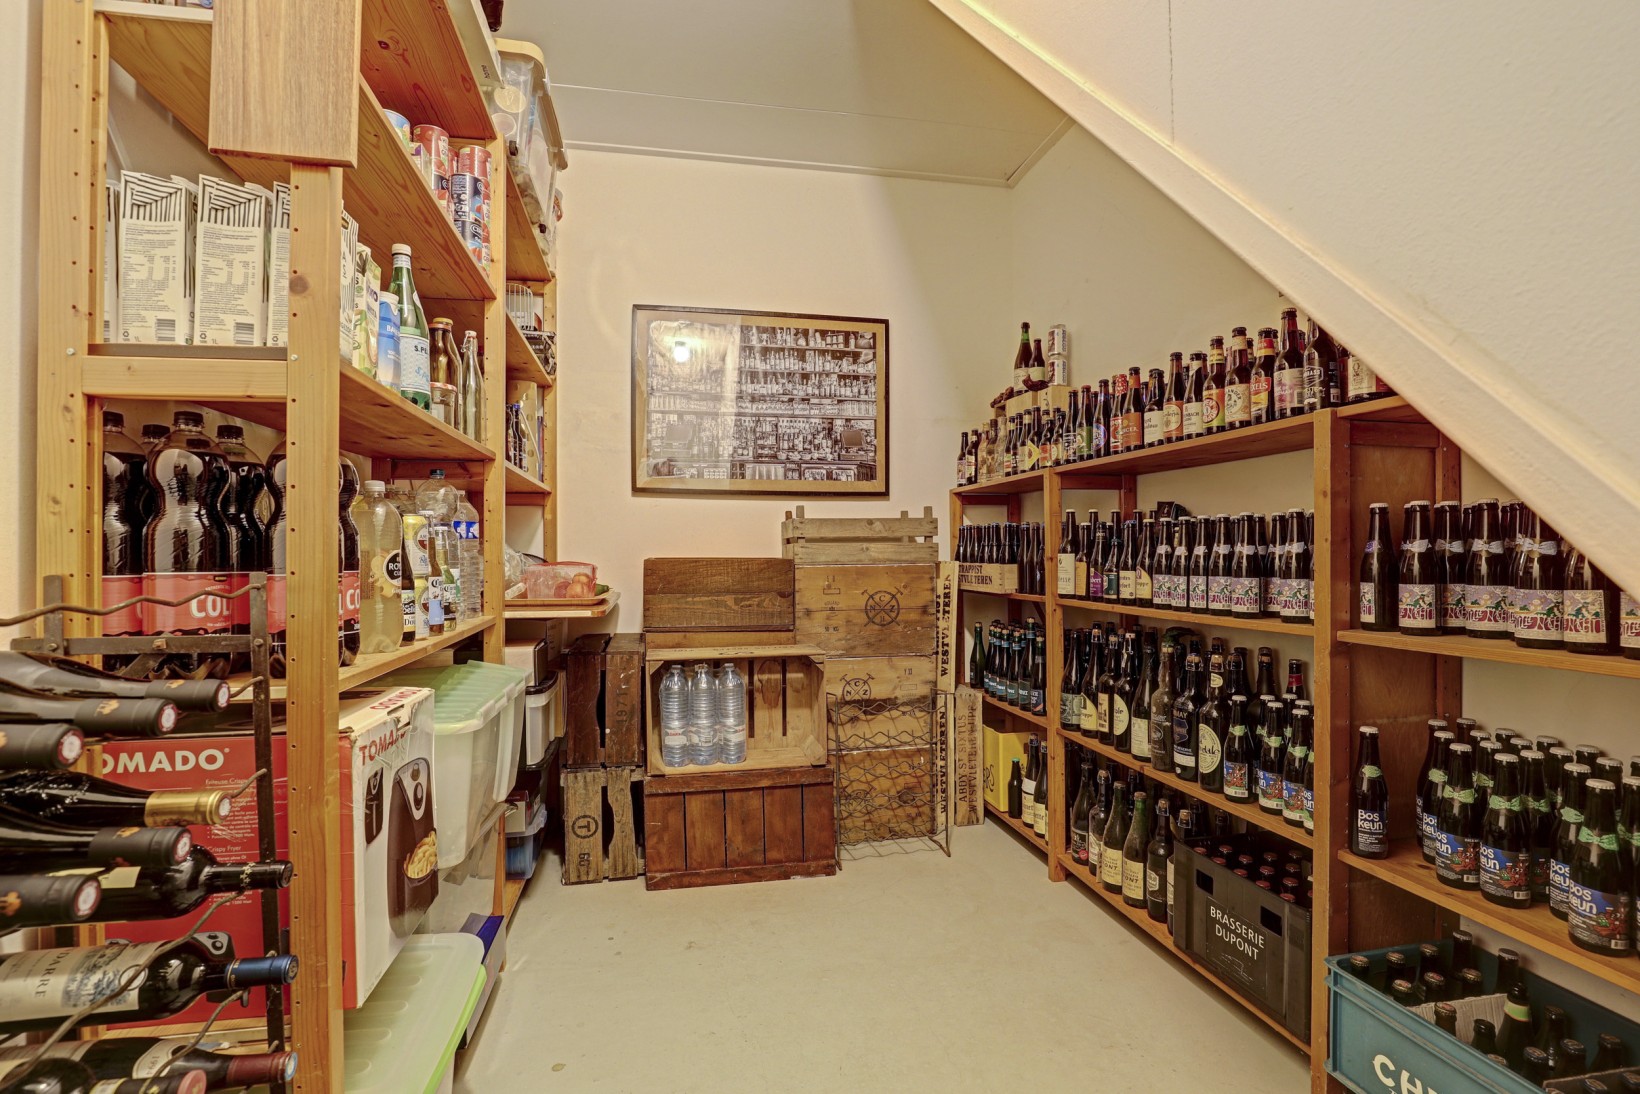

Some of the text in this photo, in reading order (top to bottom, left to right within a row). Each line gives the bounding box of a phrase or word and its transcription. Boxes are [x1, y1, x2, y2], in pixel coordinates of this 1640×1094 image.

[1358, 809, 1380, 821] Bos
[1358, 818, 1383, 830] keun
[1210, 905, 1265, 949] BRASSERIE
[1215, 924, 1259, 960] DUPONT
[1372, 1054, 1438, 1094] CH
